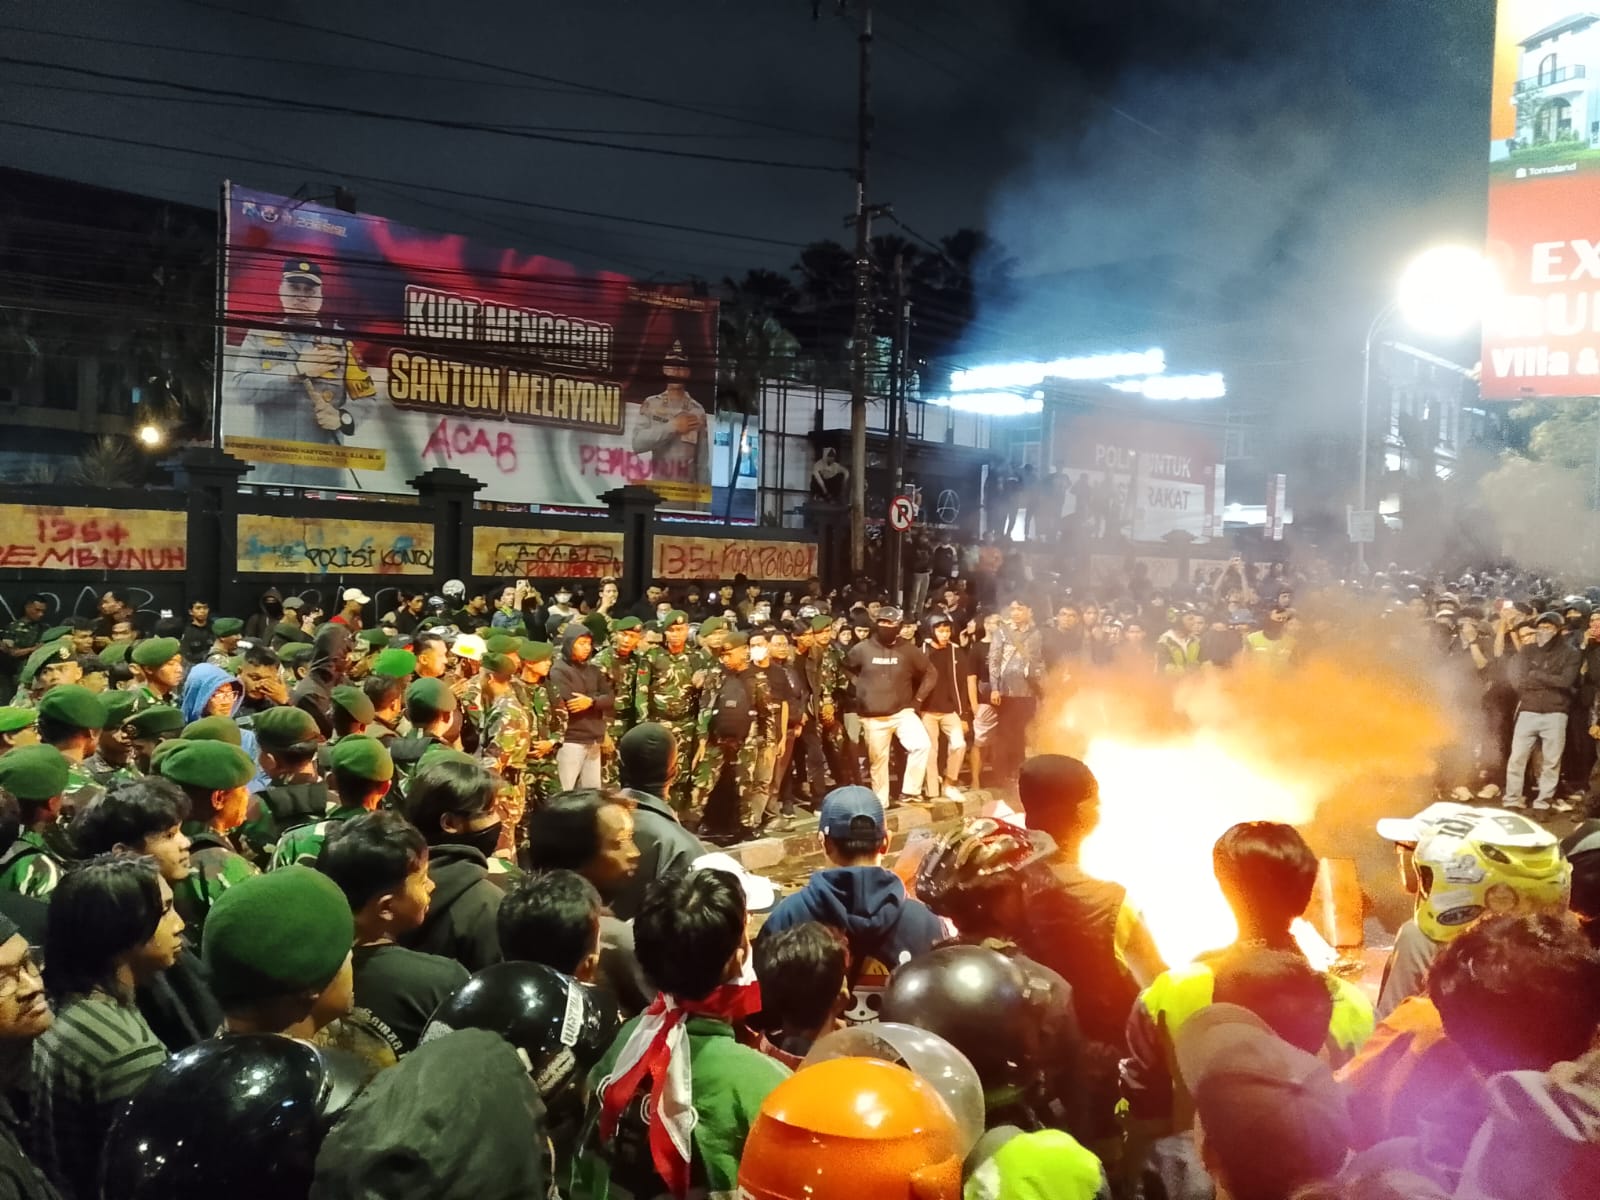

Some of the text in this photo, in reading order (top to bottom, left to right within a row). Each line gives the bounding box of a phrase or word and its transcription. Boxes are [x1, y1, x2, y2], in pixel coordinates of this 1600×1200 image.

[409, 292, 478, 341] KUAT
[1491, 347, 1569, 377] Villa
[391, 353, 620, 426] SANTUN MELAYANI
[421, 418, 518, 473] ACAB
[0, 544, 185, 569] EMBUNUH
[304, 546, 376, 568] POLISI
[659, 543, 718, 574] 135+
